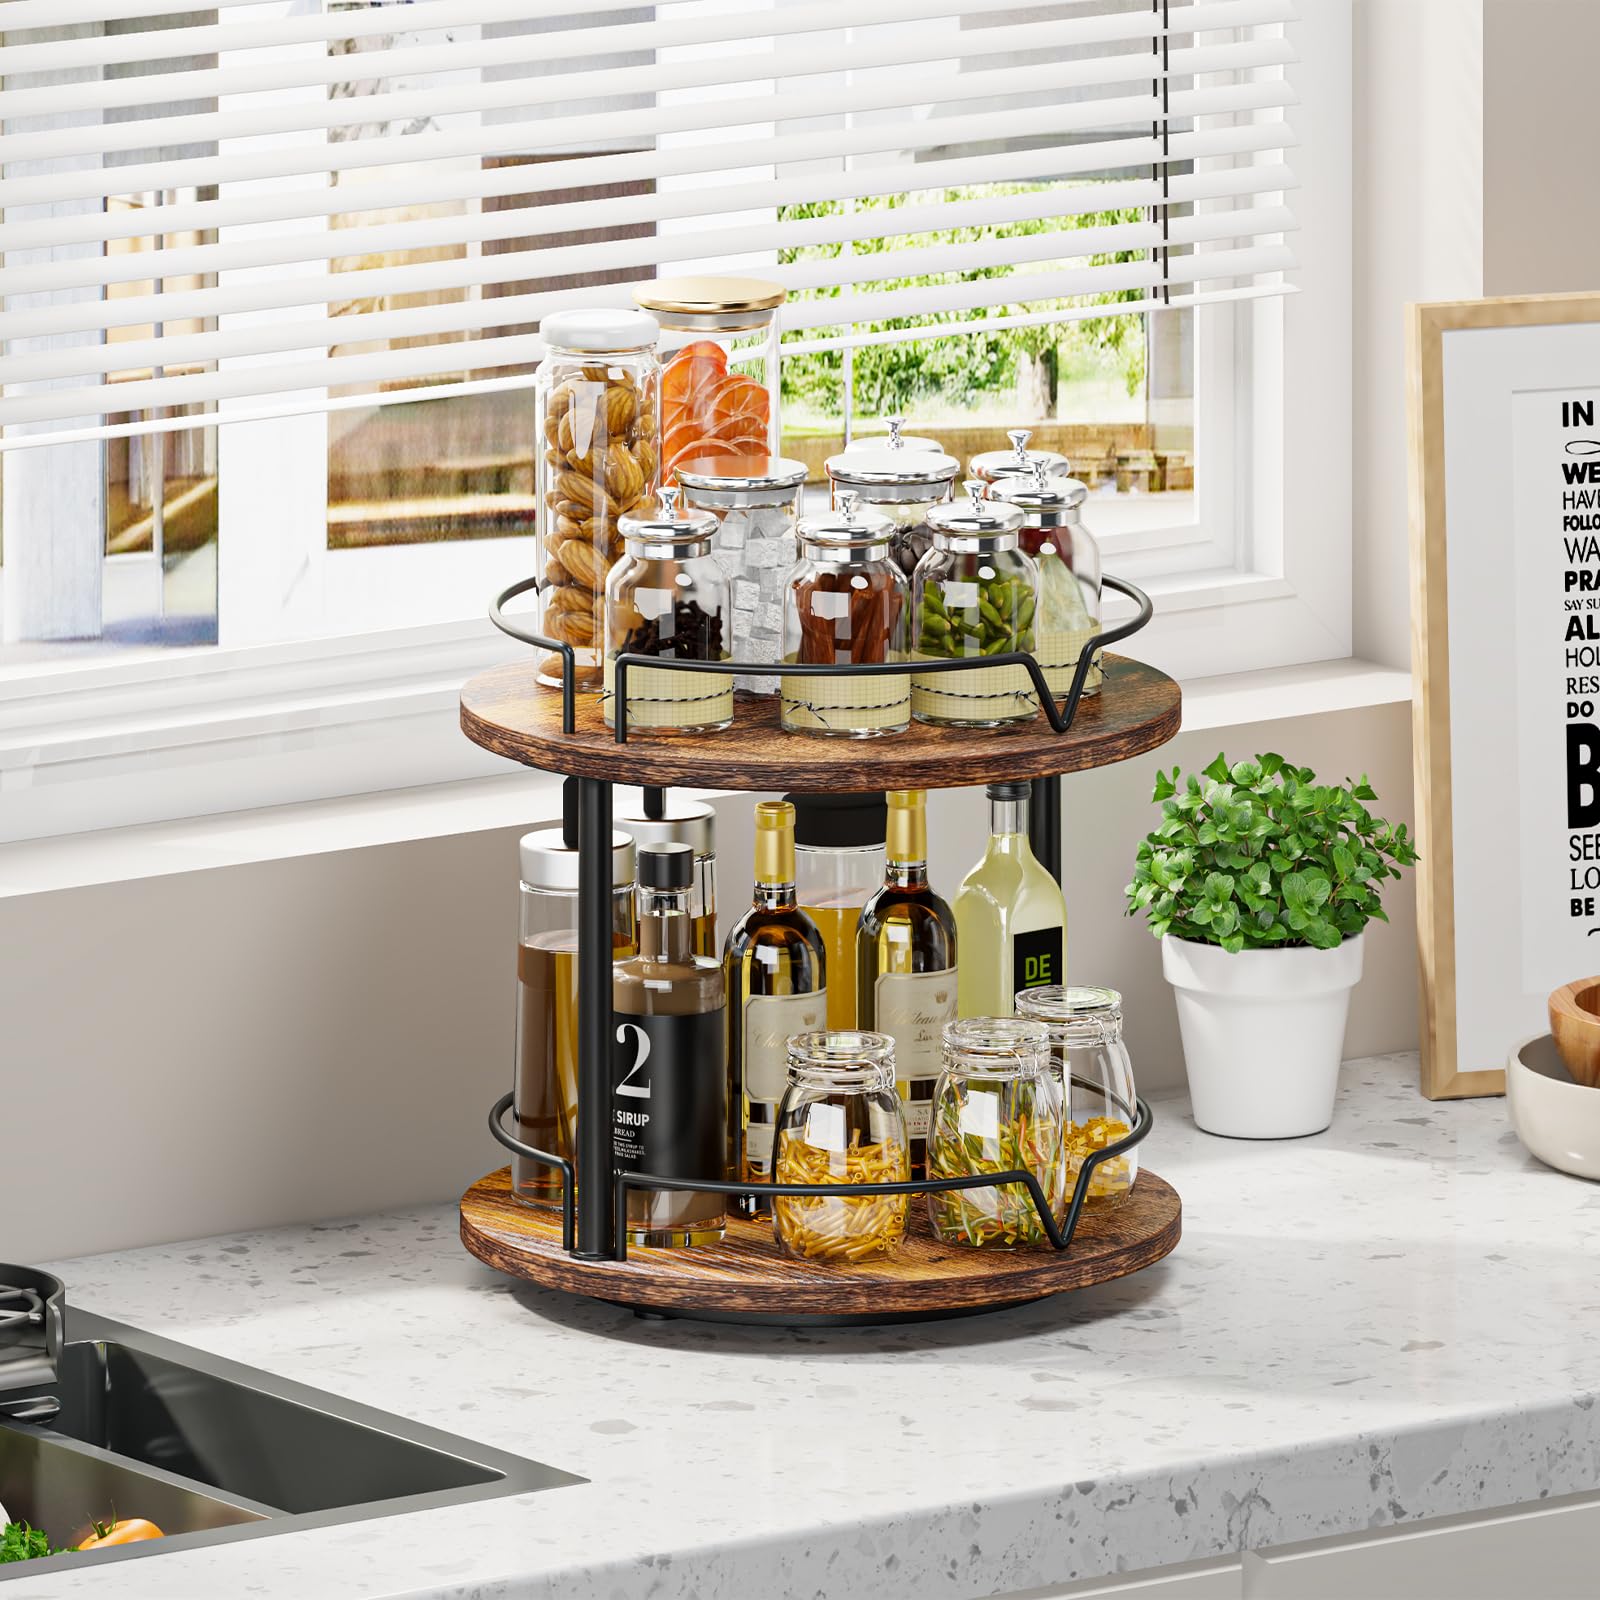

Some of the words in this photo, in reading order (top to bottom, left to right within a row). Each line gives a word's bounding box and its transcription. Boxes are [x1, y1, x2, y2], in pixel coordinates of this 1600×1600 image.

[1562, 400, 1594, 427] IN
[1561, 461, 1600, 484] WE
[1563, 513, 1600, 532] FOLLO
[1564, 536, 1600, 564] WA
[1564, 599, 1583, 611] SAY
[1565, 614, 1600, 641] AL
[1567, 675, 1600, 695] RES
[1567, 700, 1595, 718] DO
[1570, 866, 1600, 890] LO
[1570, 897, 1595, 917] BE
[1025, 953, 1052, 981] DE
[615, 1023, 651, 1099] 2
[616, 1110, 651, 1127] SIRUP
